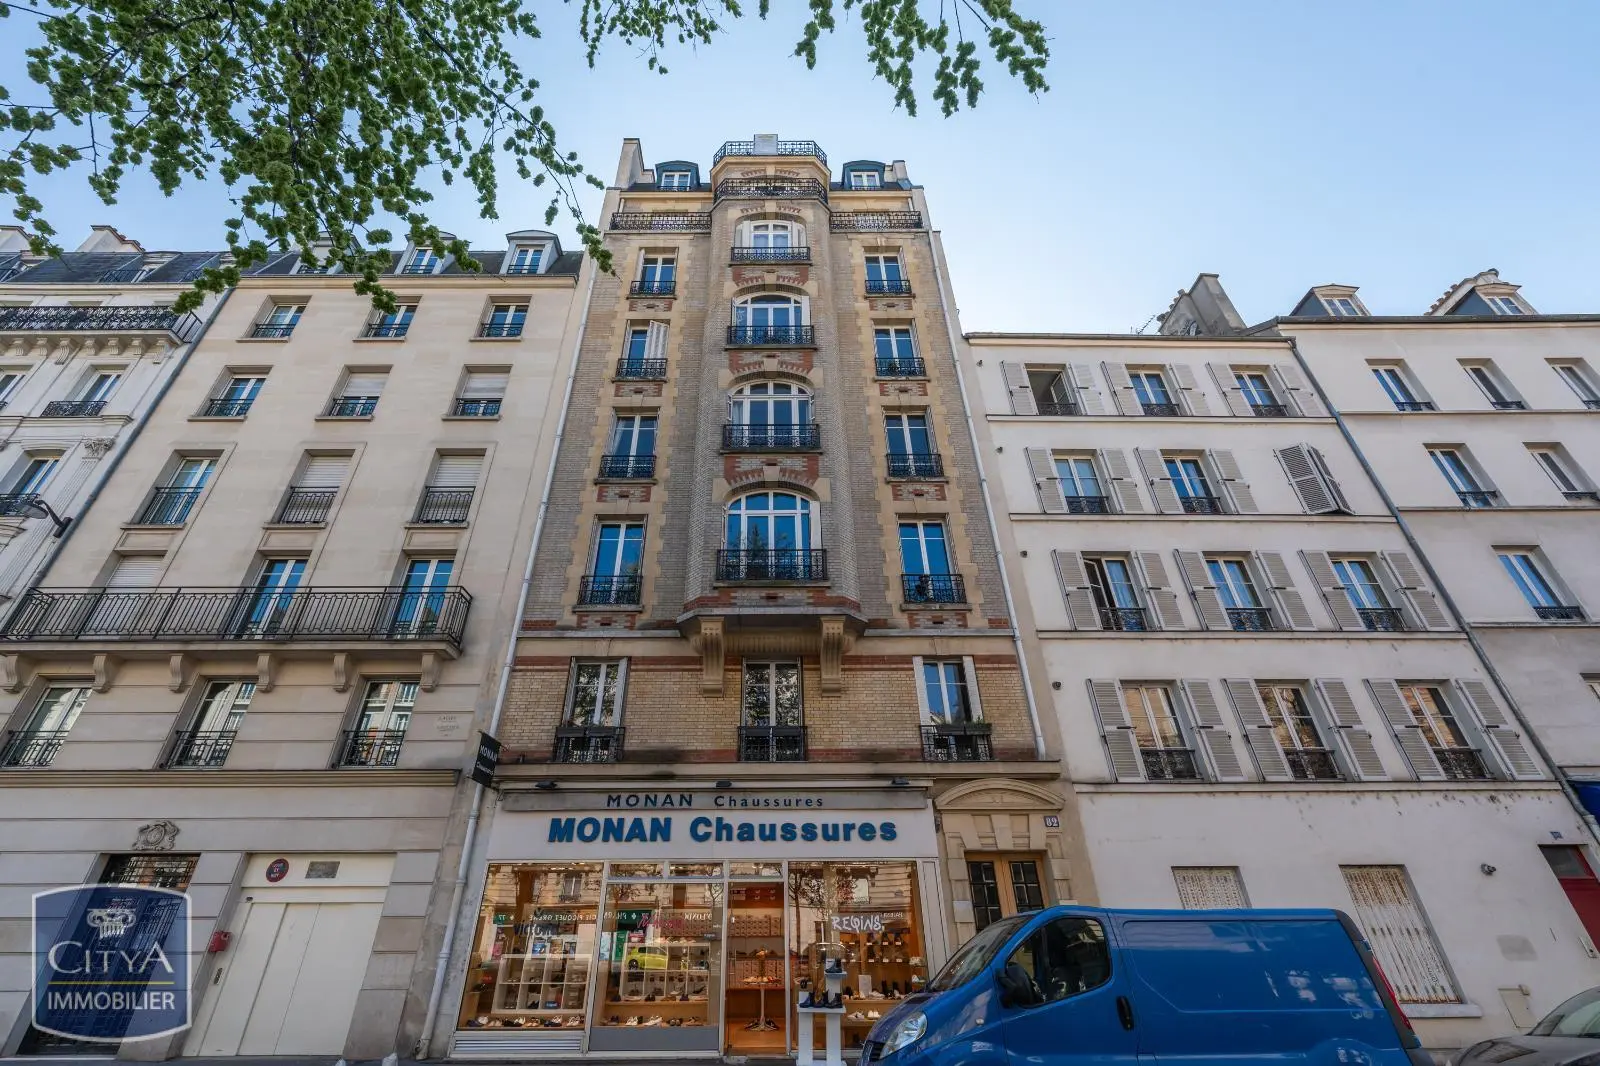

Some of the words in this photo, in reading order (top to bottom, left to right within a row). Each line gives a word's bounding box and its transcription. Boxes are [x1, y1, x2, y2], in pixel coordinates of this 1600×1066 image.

[606, 793, 693, 808] MONAN
[714, 794, 824, 808] Chaussures
[548, 816, 672, 842] MONAN
[689, 816, 897, 842] Chaussures
